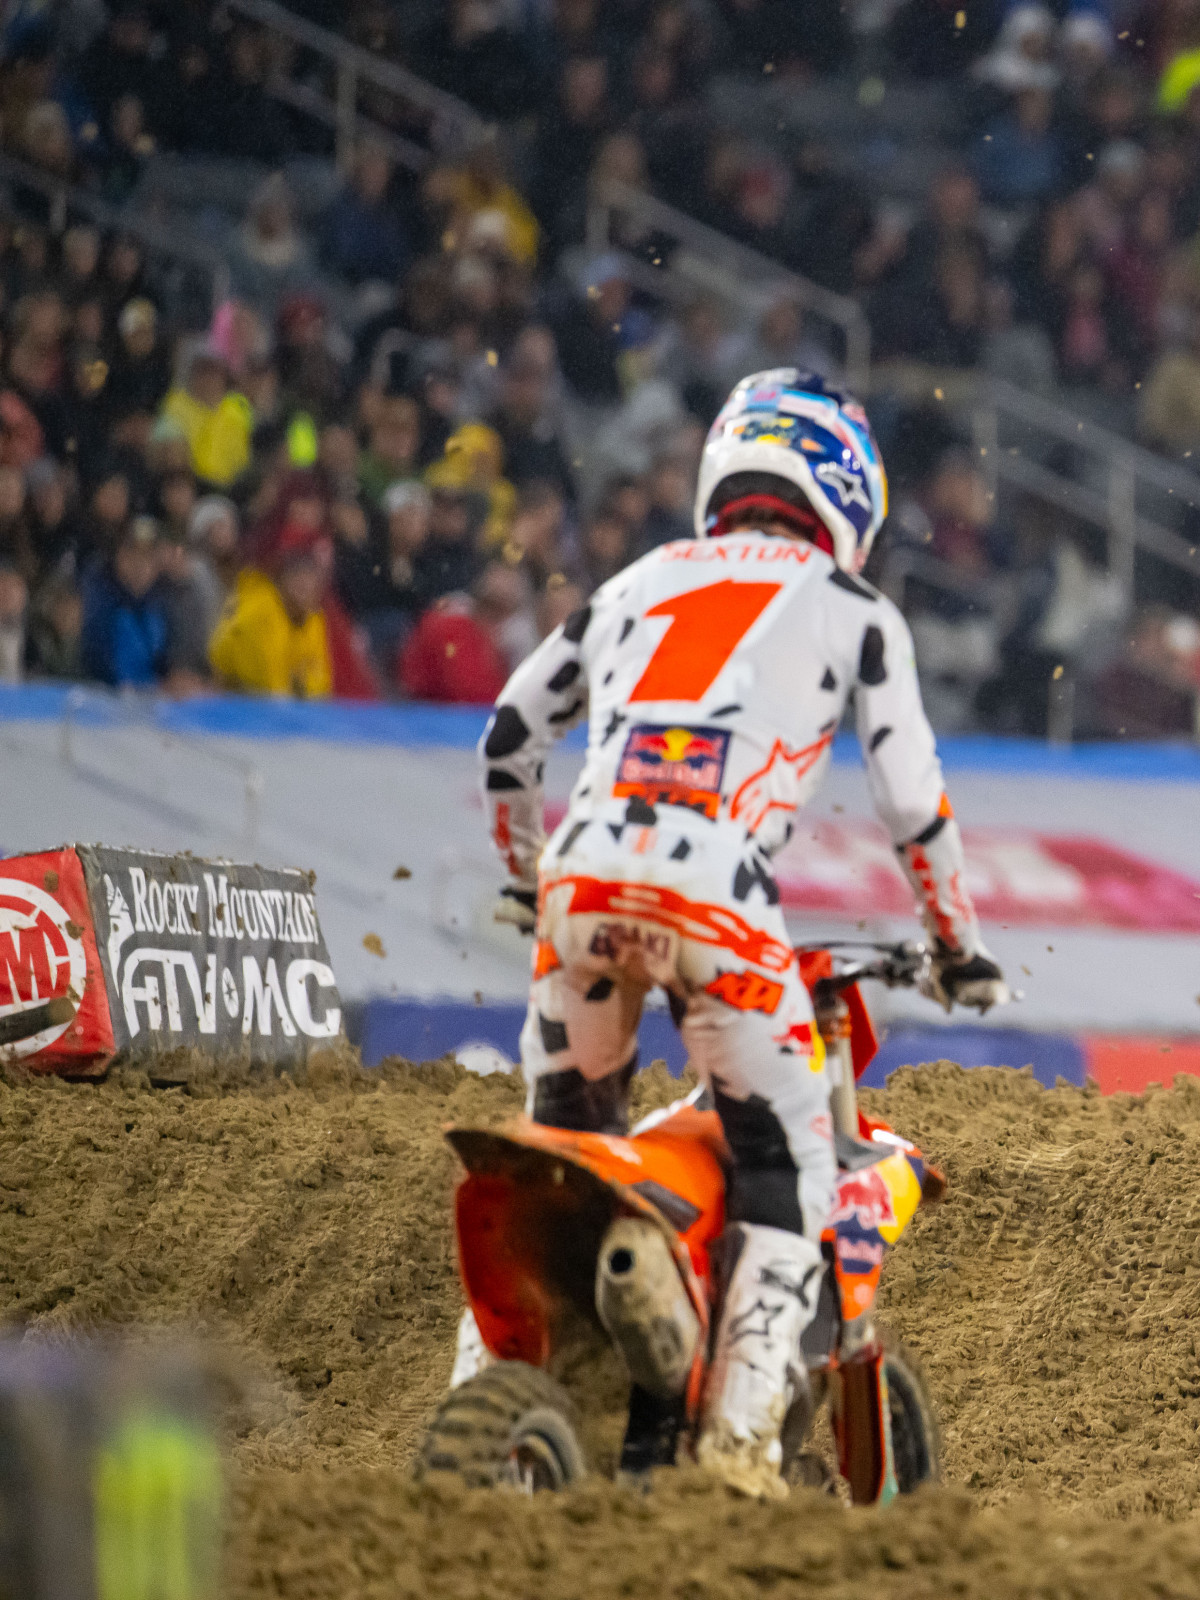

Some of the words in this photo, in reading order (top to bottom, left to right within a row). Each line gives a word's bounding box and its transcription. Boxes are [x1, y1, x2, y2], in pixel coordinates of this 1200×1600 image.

[627, 578, 785, 703] 1
[128, 866, 202, 936] ROCKY
[203, 872, 319, 944] MOUNTAIN
